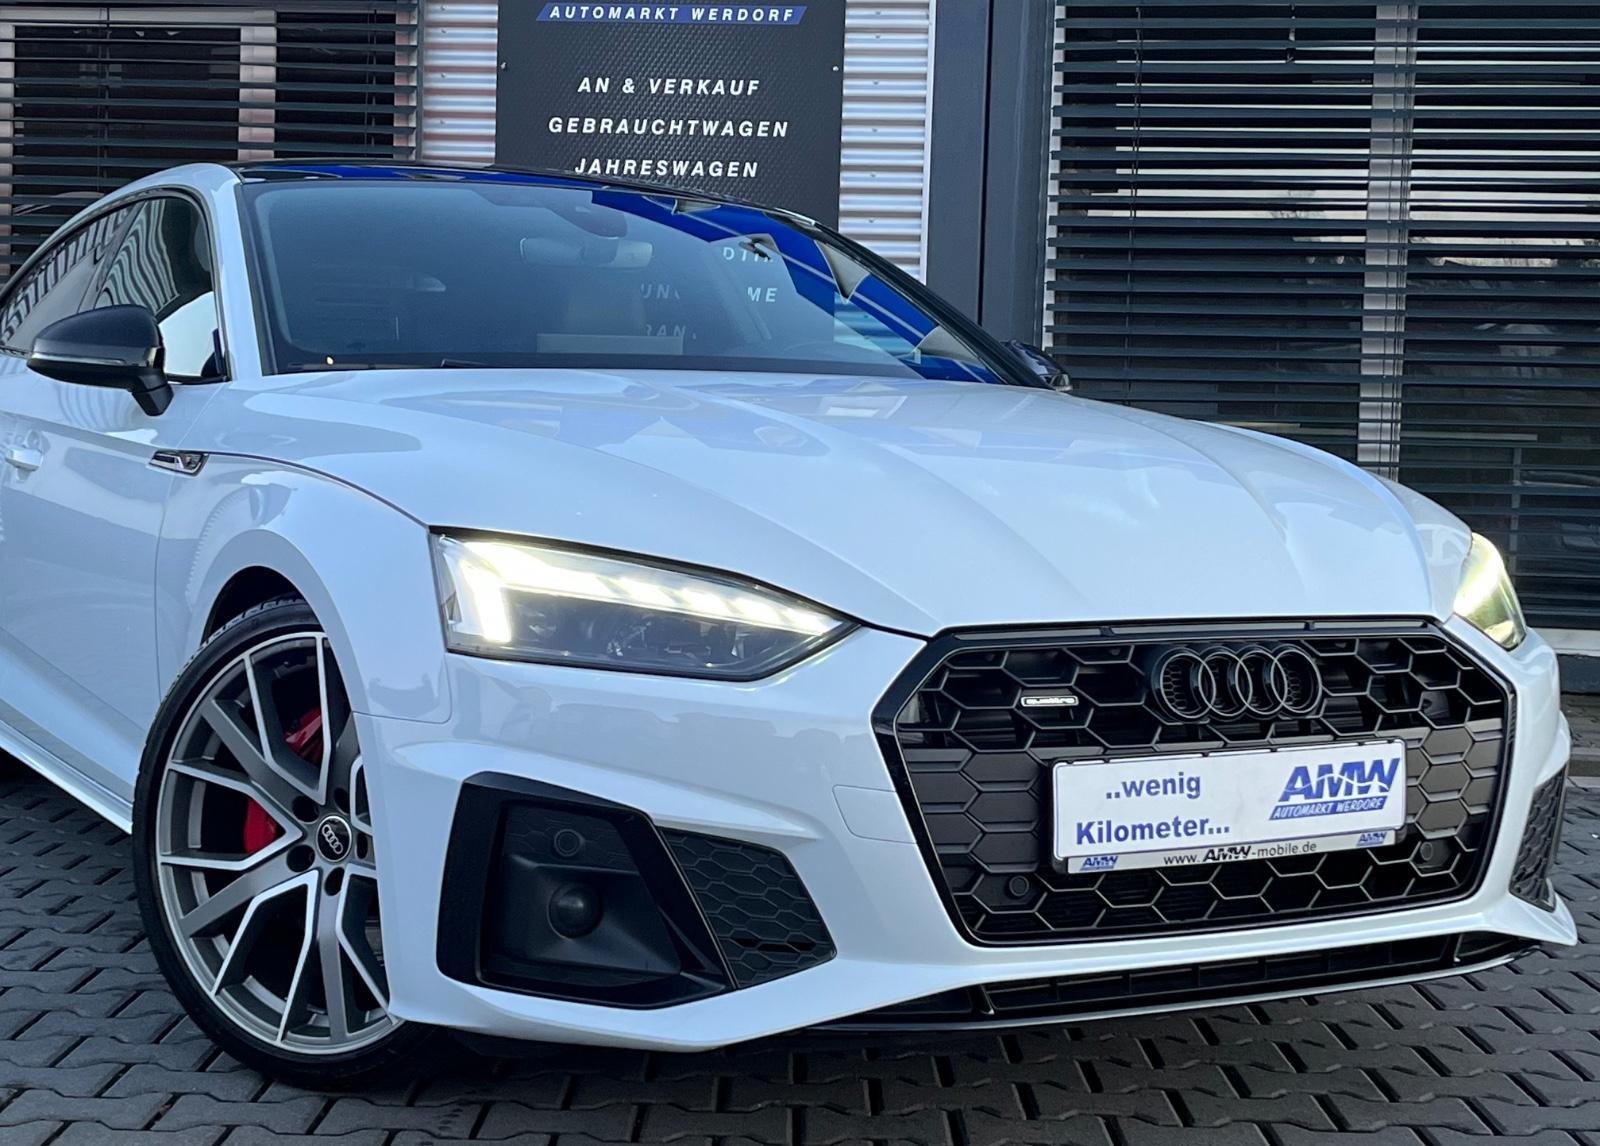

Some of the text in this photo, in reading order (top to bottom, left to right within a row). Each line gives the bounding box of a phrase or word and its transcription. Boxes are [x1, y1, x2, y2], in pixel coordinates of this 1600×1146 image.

[549, 5, 794, 22] AUTOMARKT WERDORF
[577, 77, 760, 96] AN & VERKAUF
[548, 117, 790, 138] GEBRAUCHTWAGEN
[575, 158, 758, 178] JAHRESWAGEN
[1278, 757, 1401, 802] AMW
[1272, 797, 1385, 819] AUTOMARKT WERDORF
[1075, 815, 1231, 846] Kilometer...
